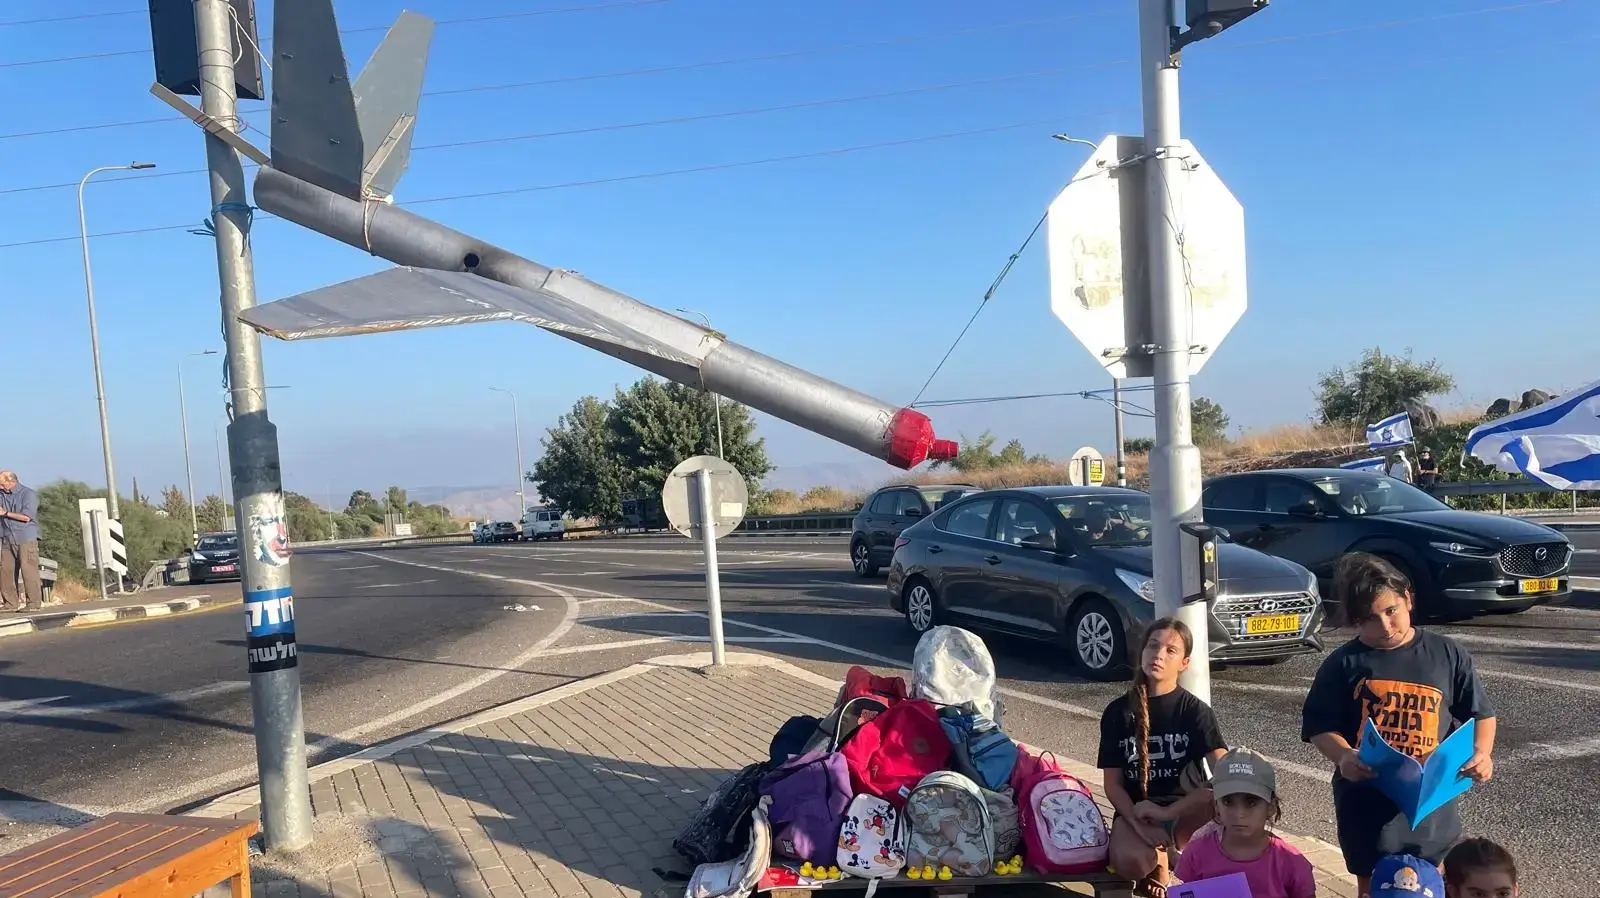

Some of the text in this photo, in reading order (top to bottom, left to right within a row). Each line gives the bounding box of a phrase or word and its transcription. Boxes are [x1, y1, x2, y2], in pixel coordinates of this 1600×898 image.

[249, 641, 296, 663] חלשה
[1384, 692, 1439, 713] צומת
[1413, 735, 1434, 747] טוב
